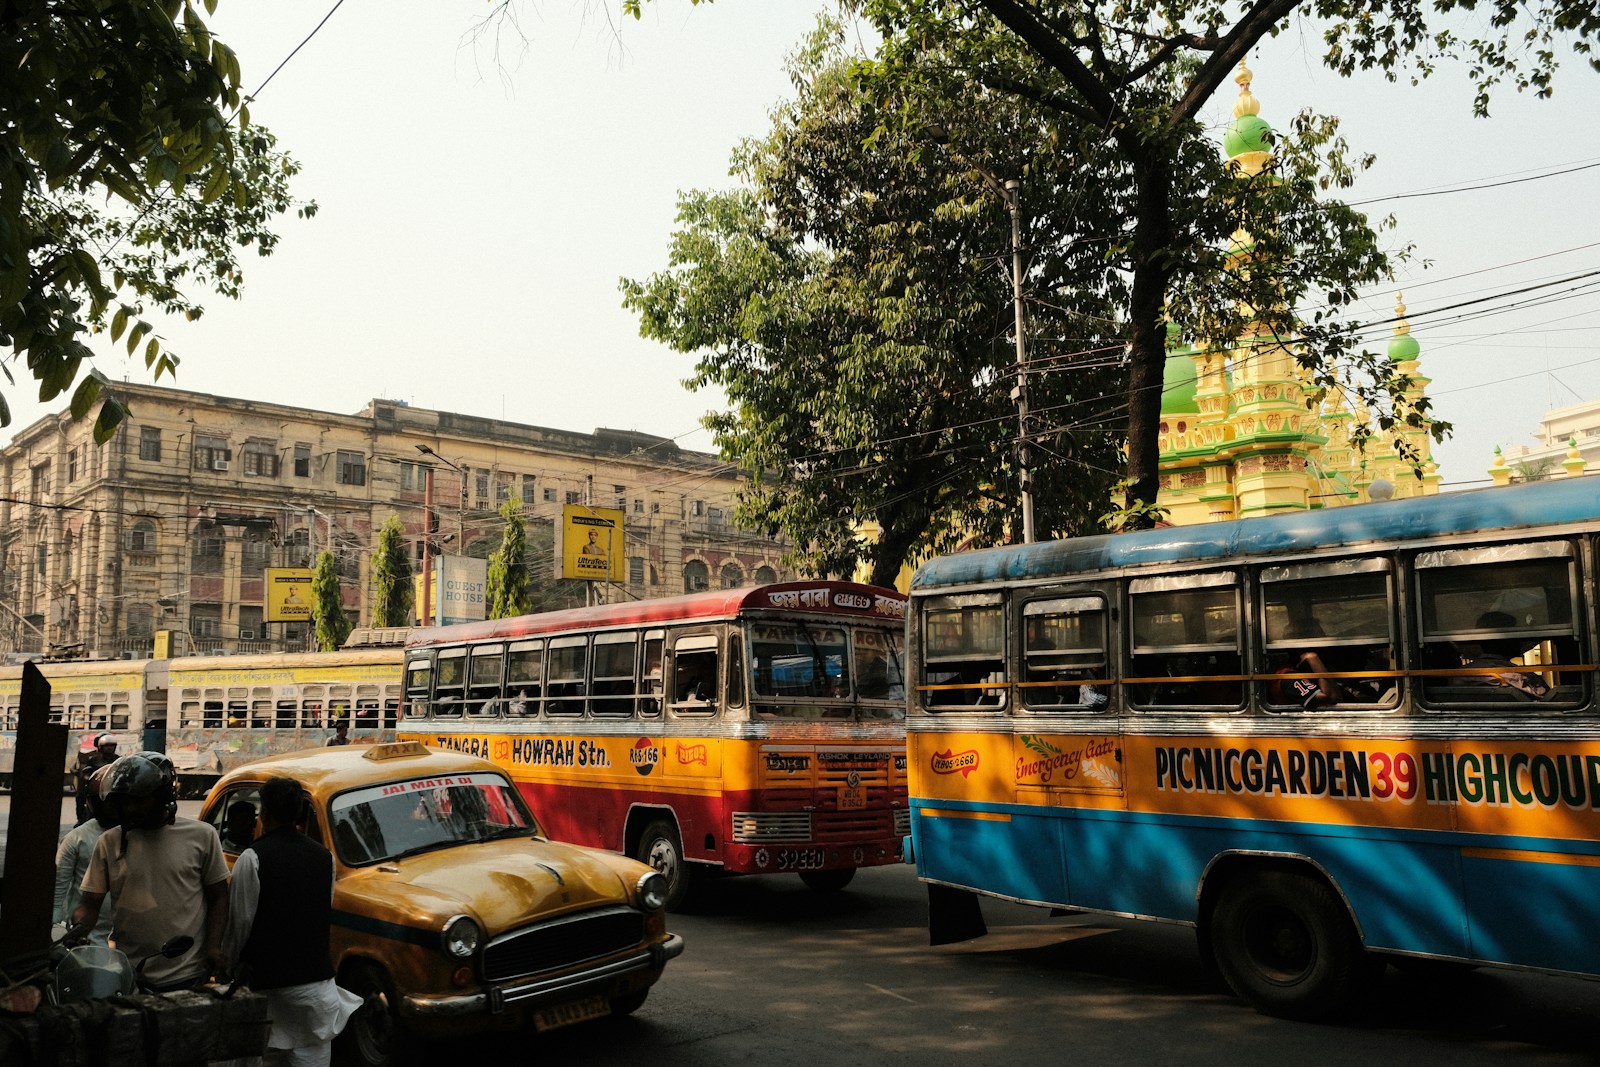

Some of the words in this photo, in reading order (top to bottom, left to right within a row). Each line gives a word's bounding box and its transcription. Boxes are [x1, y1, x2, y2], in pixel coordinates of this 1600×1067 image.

[577, 556, 611, 566] UltraTec
[446, 580, 483, 592] GUEST
[446, 591, 483, 603] HOUSE
[800, 588, 830, 608] বাবা
[383, 743, 418, 756] TAXI
[512, 738, 575, 766] HOWRAH
[578, 740, 612, 768] Stn.
[1015, 748, 1083, 782] Emergency
[1085, 737, 1114, 760] Gate
[1155, 746, 1371, 799] PICNICGARDEN
[1368, 752, 1418, 801] 39
[382, 785, 406, 796] JAI
[410, 777, 454, 793] MATA
[458, 777, 473, 785] DI
[777, 849, 825, 870] SPEED
